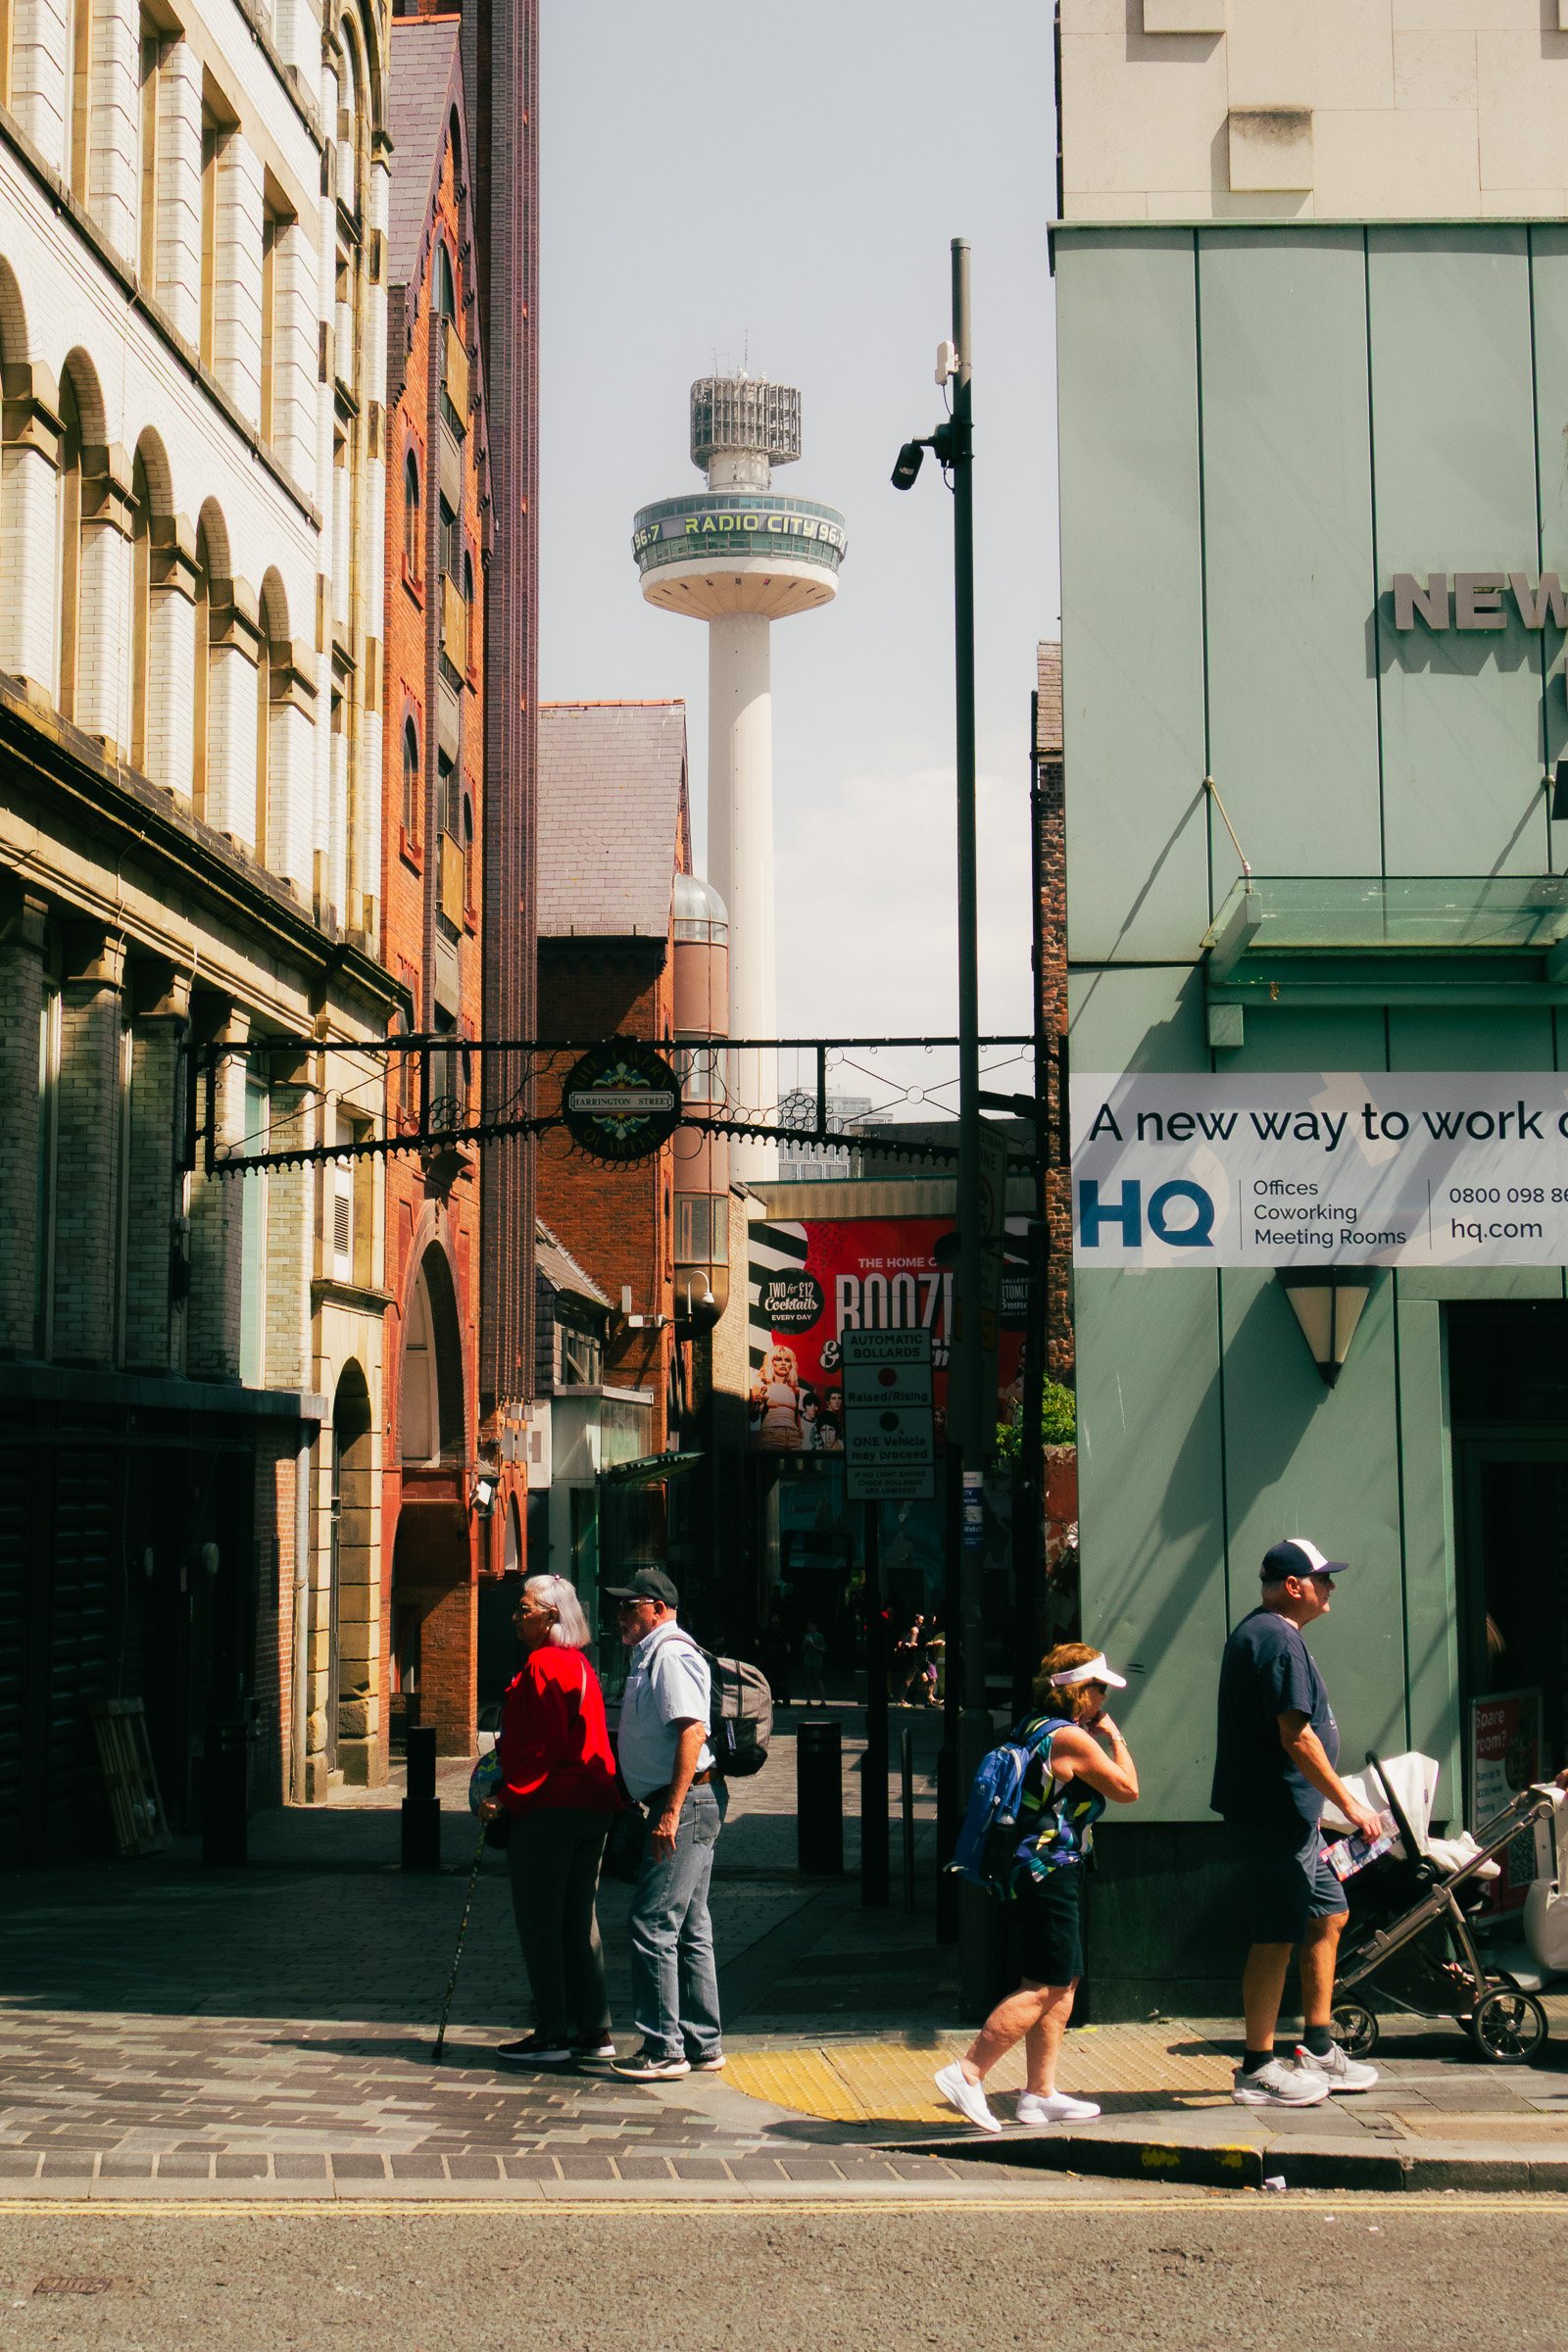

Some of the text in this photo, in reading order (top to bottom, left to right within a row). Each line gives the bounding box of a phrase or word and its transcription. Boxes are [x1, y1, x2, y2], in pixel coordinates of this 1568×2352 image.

[685, 514, 760, 534] RADIO
[767, 515, 815, 538] CITY
[1393, 572, 1568, 630] NEW
[573, 1097, 671, 1106] HARRINGTON STREET
[1089, 1103, 1123, 1142] A
[1137, 1110, 1238, 1142] new
[1250, 1110, 1348, 1152] way
[1361, 1102, 1409, 1141] to
[1422, 1101, 1544, 1141] work
[1253, 1180, 1318, 1196] Offices
[1449, 1188, 1500, 1203] 0800
[1506, 1187, 1544, 1202] 098
[1079, 1179, 1215, 1248] HQ
[1253, 1203, 1357, 1224] Coworking
[1254, 1228, 1406, 1249] Meeting Rooms
[1450, 1218, 1544, 1244] hq.com
[858, 1258, 883, 1268] THE
[886, 1257, 924, 1268] HOME
[768, 1281, 814, 1298] TWO for £12
[764, 1298, 819, 1311] Cocktails
[851, 1334, 923, 1346] AUTOMATIC
[854, 1348, 921, 1358] BOLLARDS
[848, 1392, 928, 1404] Raised/Rising
[853, 1436, 926, 1447] ONE Vehicle
[852, 1448, 928, 1462] may proceed
[1475, 1709, 1505, 1732] Spare
[1475, 1730, 1507, 1753] room?
